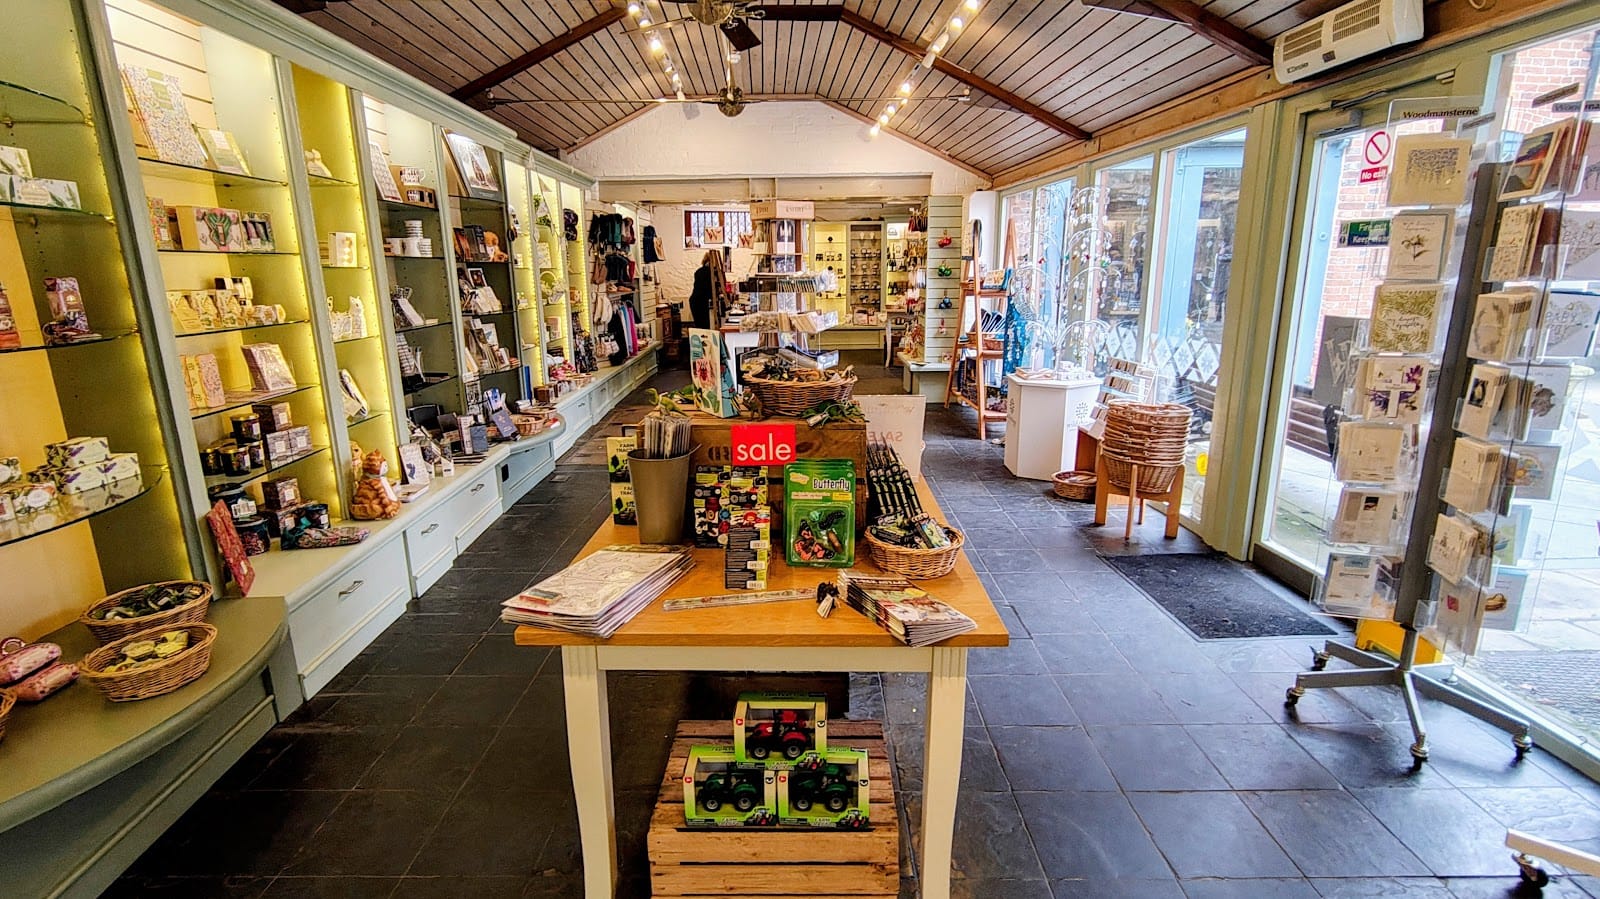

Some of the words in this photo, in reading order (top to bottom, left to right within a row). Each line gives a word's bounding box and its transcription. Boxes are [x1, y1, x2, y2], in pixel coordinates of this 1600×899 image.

[1402, 107, 1478, 119] Woodmansterne
[1361, 170, 1372, 180] No
[736, 432, 792, 462] sale
[813, 477, 850, 491] Butterfly
